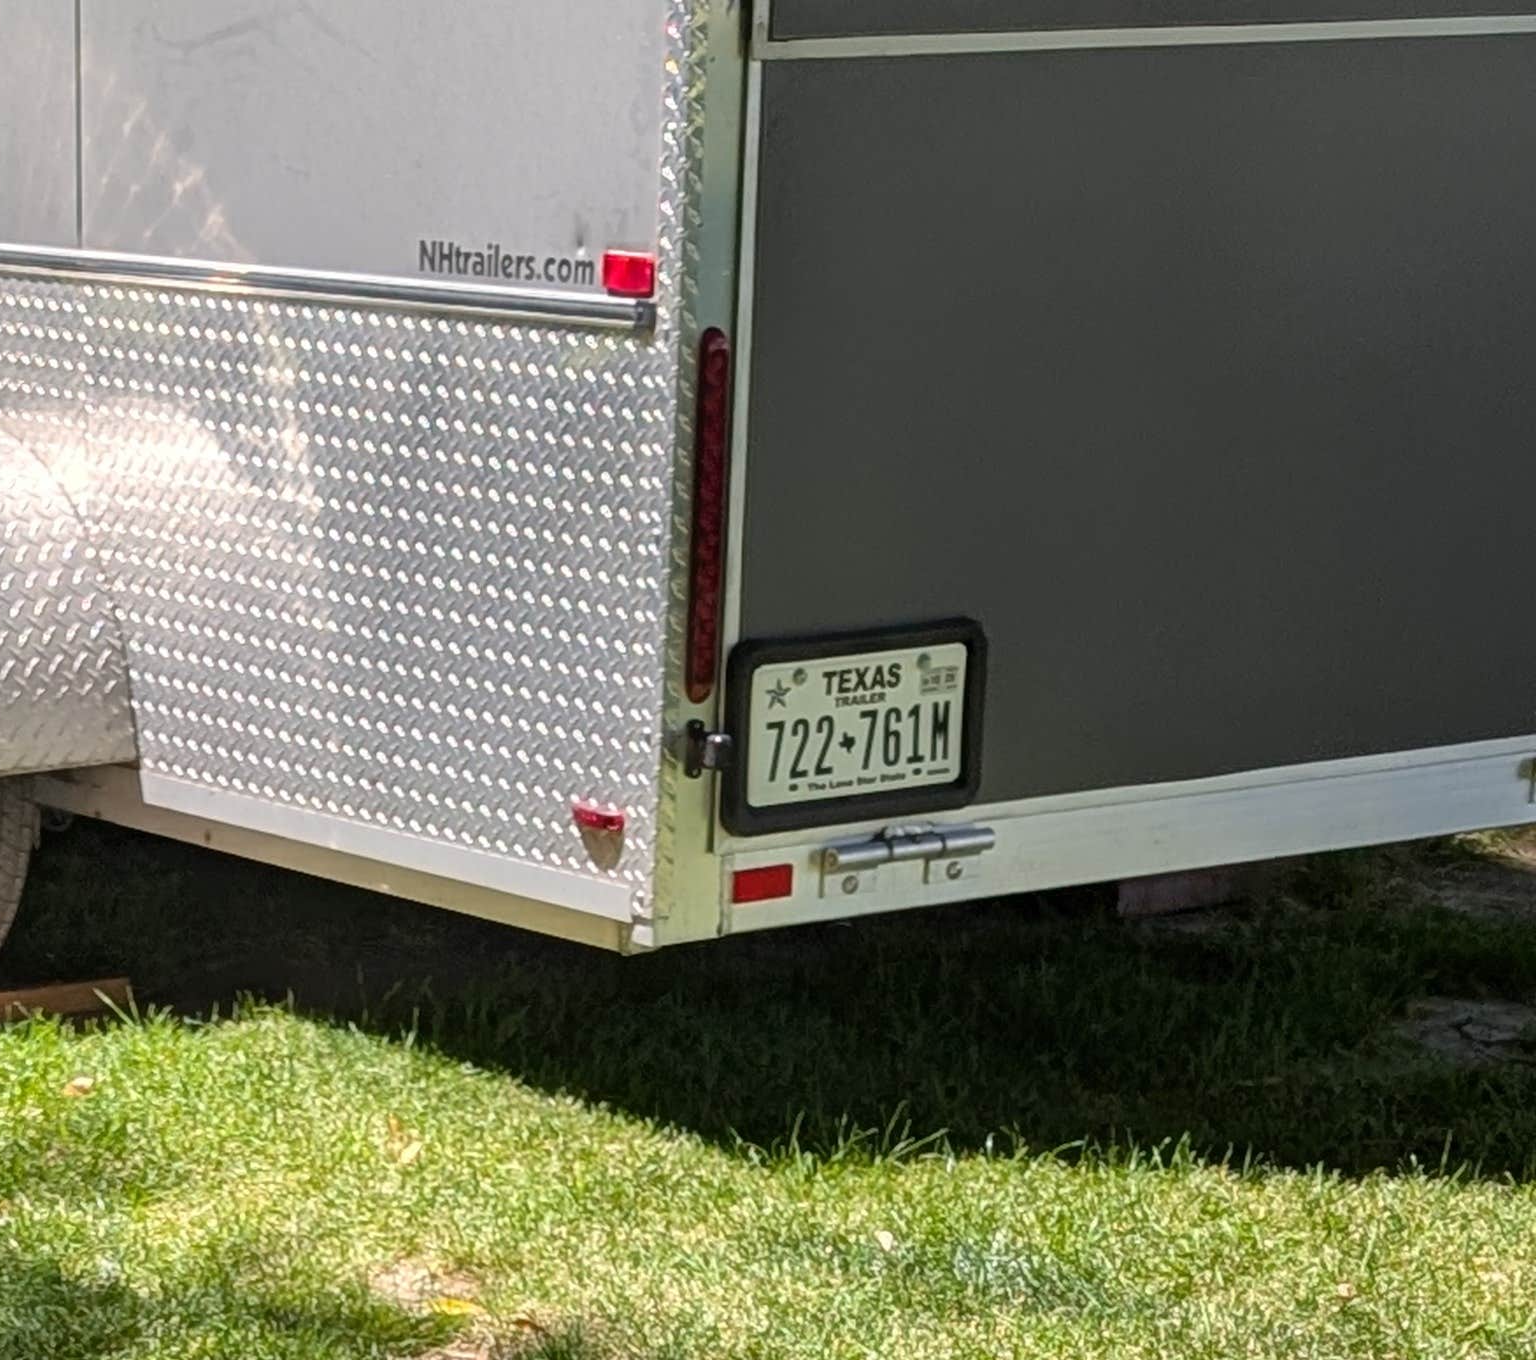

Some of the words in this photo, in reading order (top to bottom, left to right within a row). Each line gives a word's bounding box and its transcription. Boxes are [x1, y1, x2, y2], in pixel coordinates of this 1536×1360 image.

[419, 240, 595, 285] NHtrailers.com
[822, 662, 902, 696] TEXAS
[834, 692, 887, 708] TRAILER
